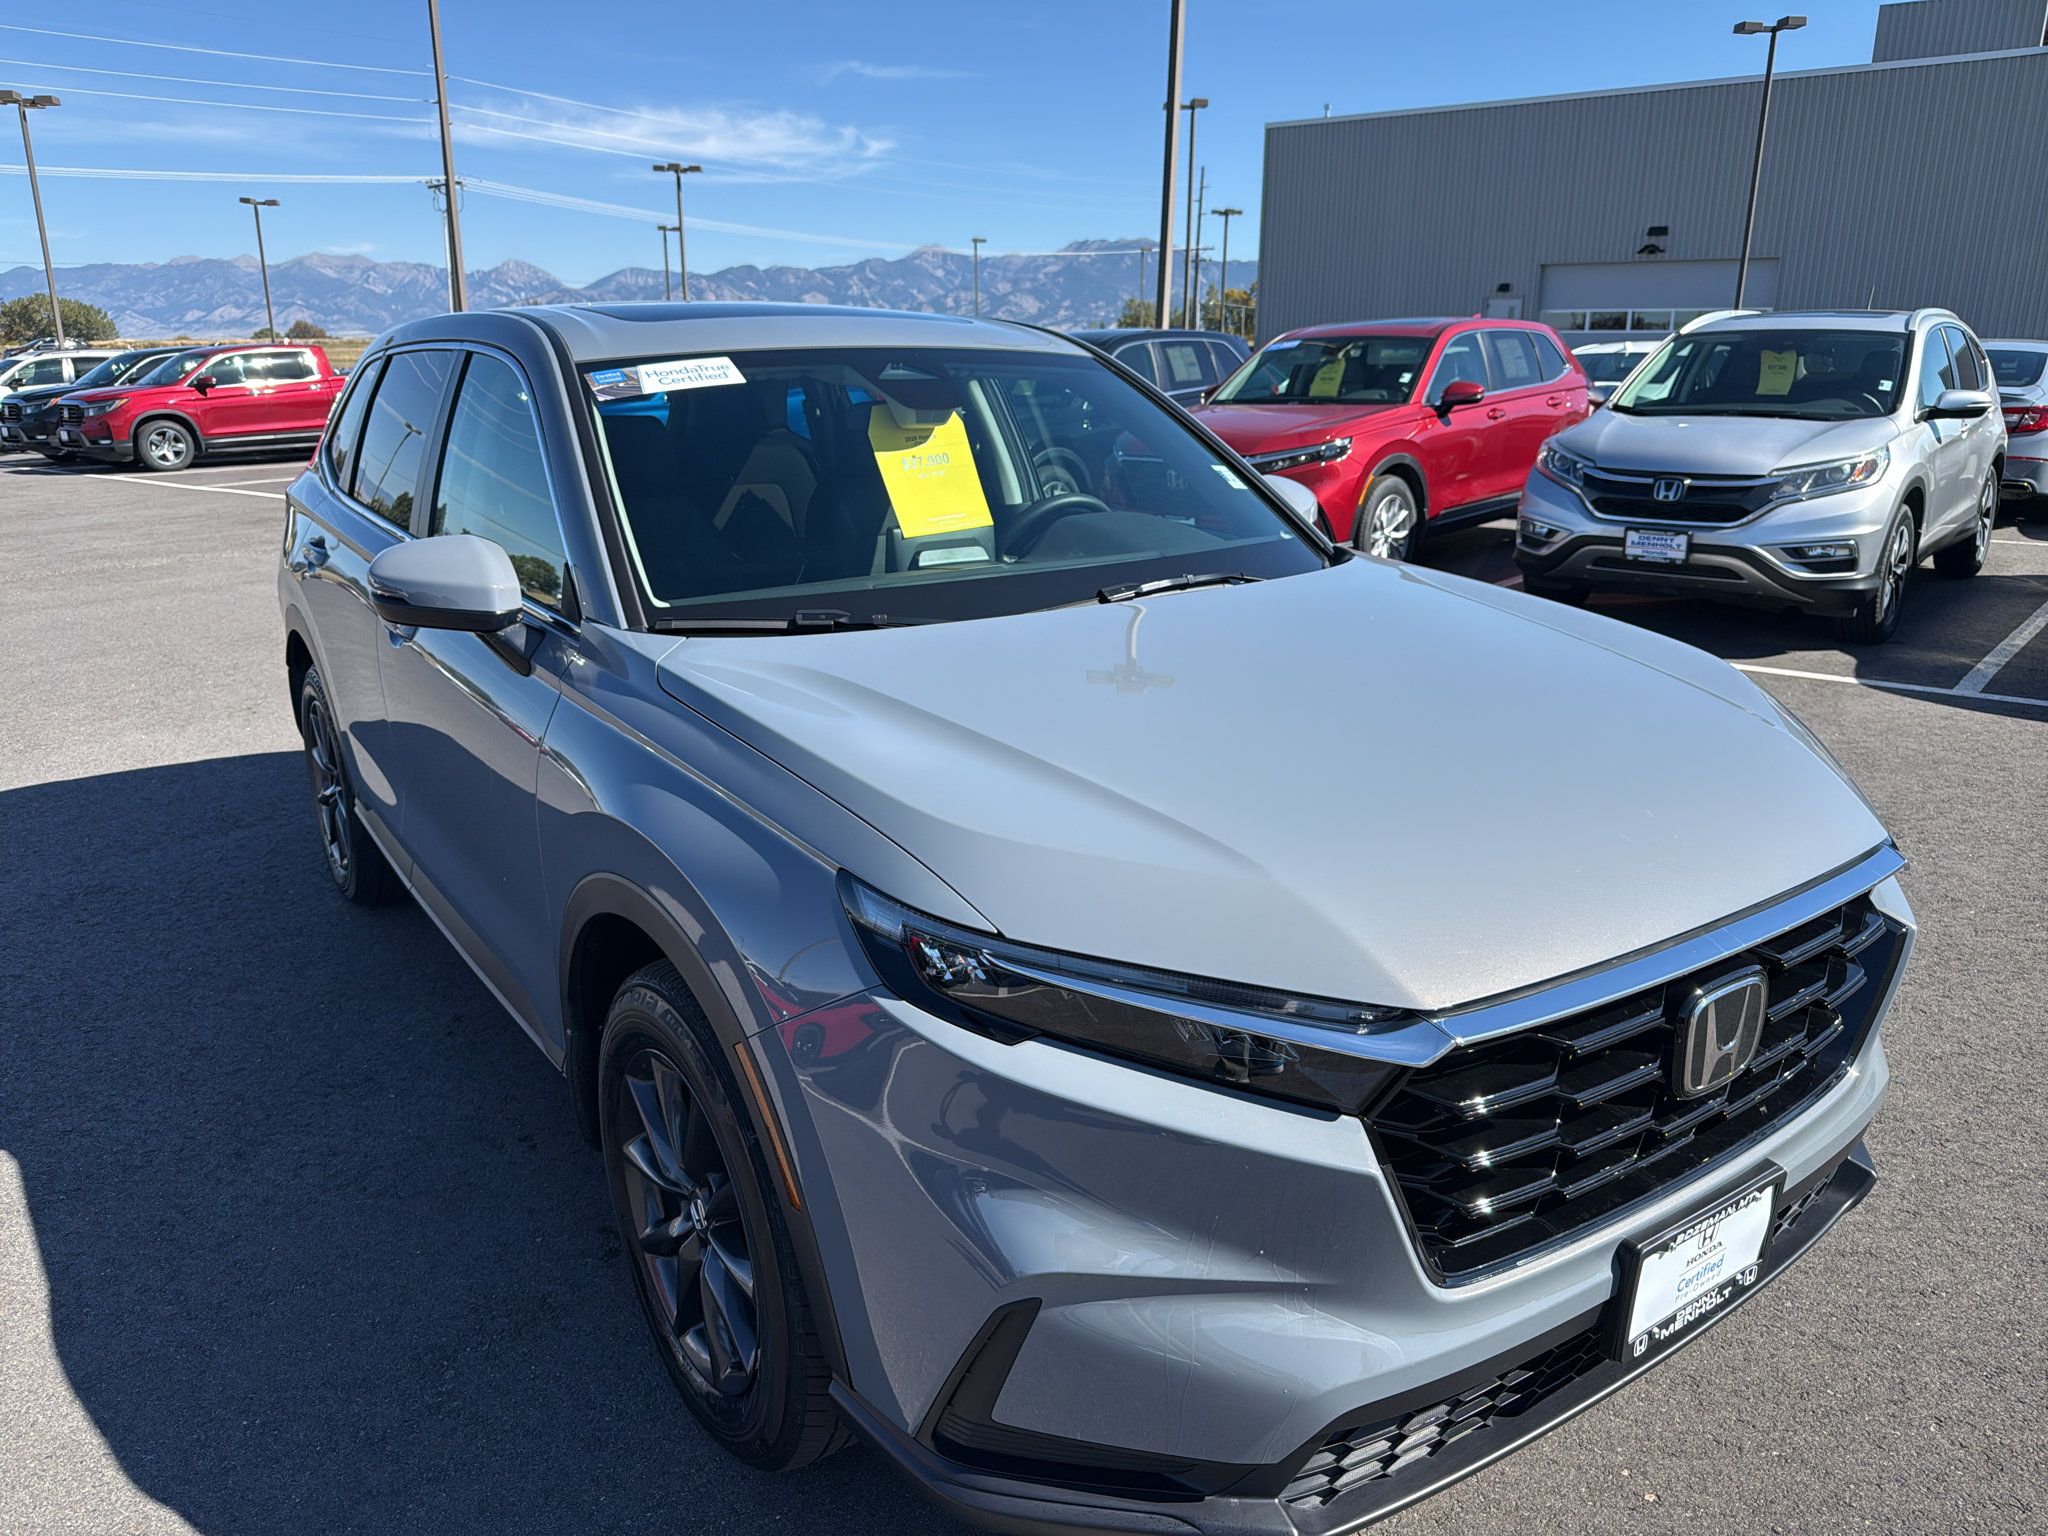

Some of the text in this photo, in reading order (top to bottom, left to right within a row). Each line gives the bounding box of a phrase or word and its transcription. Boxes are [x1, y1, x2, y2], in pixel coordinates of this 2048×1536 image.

[645, 364, 730, 379] HondaTrue
[658, 371, 729, 385] Certified
[1630, 540, 1682, 549] MENHOLT
[1638, 535, 1675, 543] DENNY
[1685, 1241, 1723, 1268] HONDA
[1675, 1268, 1722, 1303] Pre-Owned
[1677, 1253, 1725, 1292] Certified
[1660, 1286, 1733, 1341] MENHOLT
[1676, 1288, 1719, 1321] DENNY
